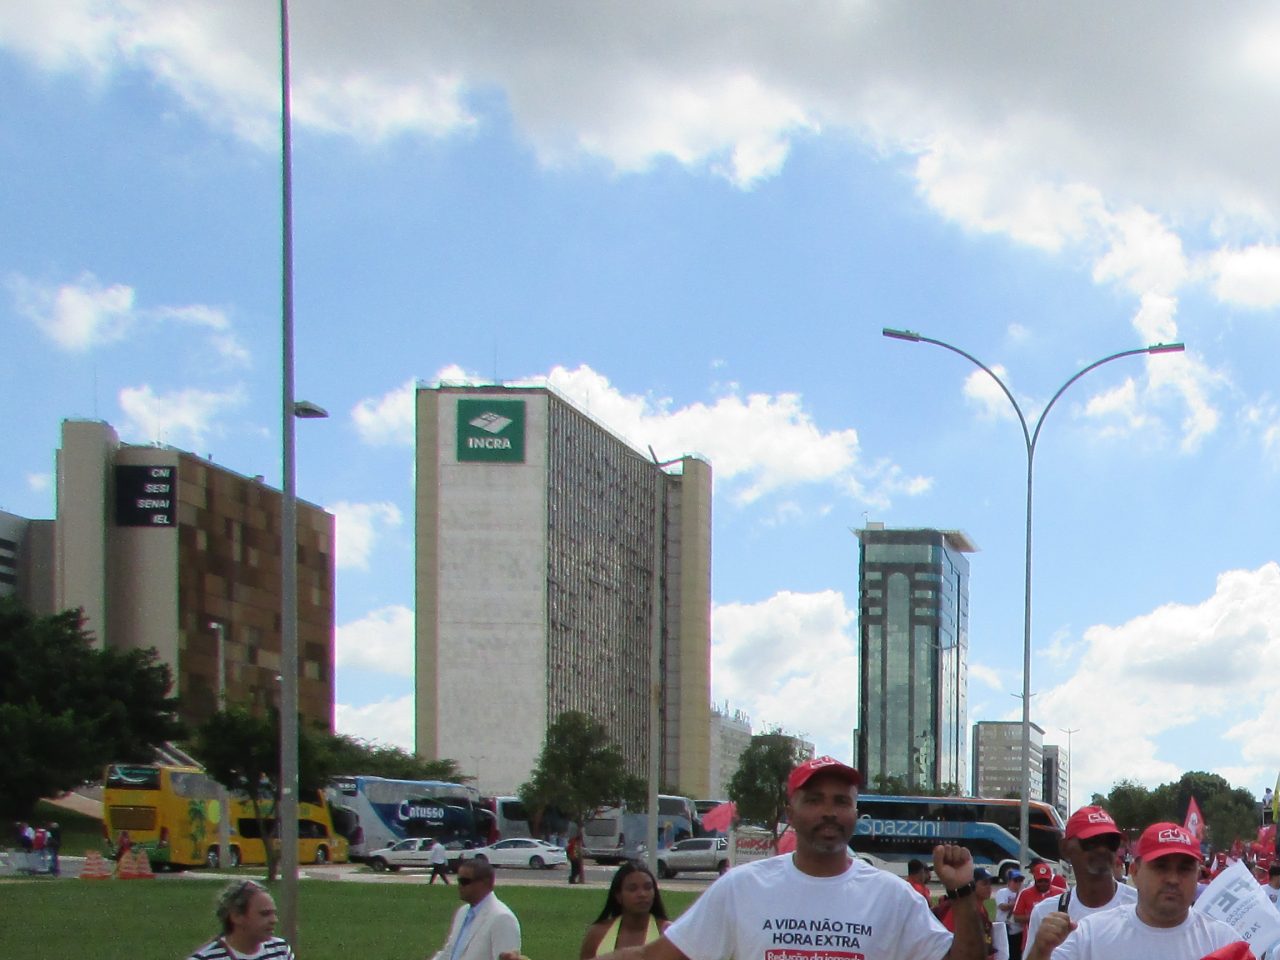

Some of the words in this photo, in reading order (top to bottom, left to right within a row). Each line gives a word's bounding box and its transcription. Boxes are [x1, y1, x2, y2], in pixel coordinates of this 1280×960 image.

[468, 438, 513, 450] INCRA
[151, 468, 171, 478] CNI
[144, 483, 170, 493] SESI
[137, 499, 170, 509] SENAI
[152, 514, 171, 524] IEL
[763, 919, 773, 930] A
[775, 919, 807, 931] VIDA
[809, 918, 843, 933] NÃO
[845, 922, 872, 937] TEM
[772, 933, 813, 946] HORA
[815, 934, 861, 949] EXTRA
